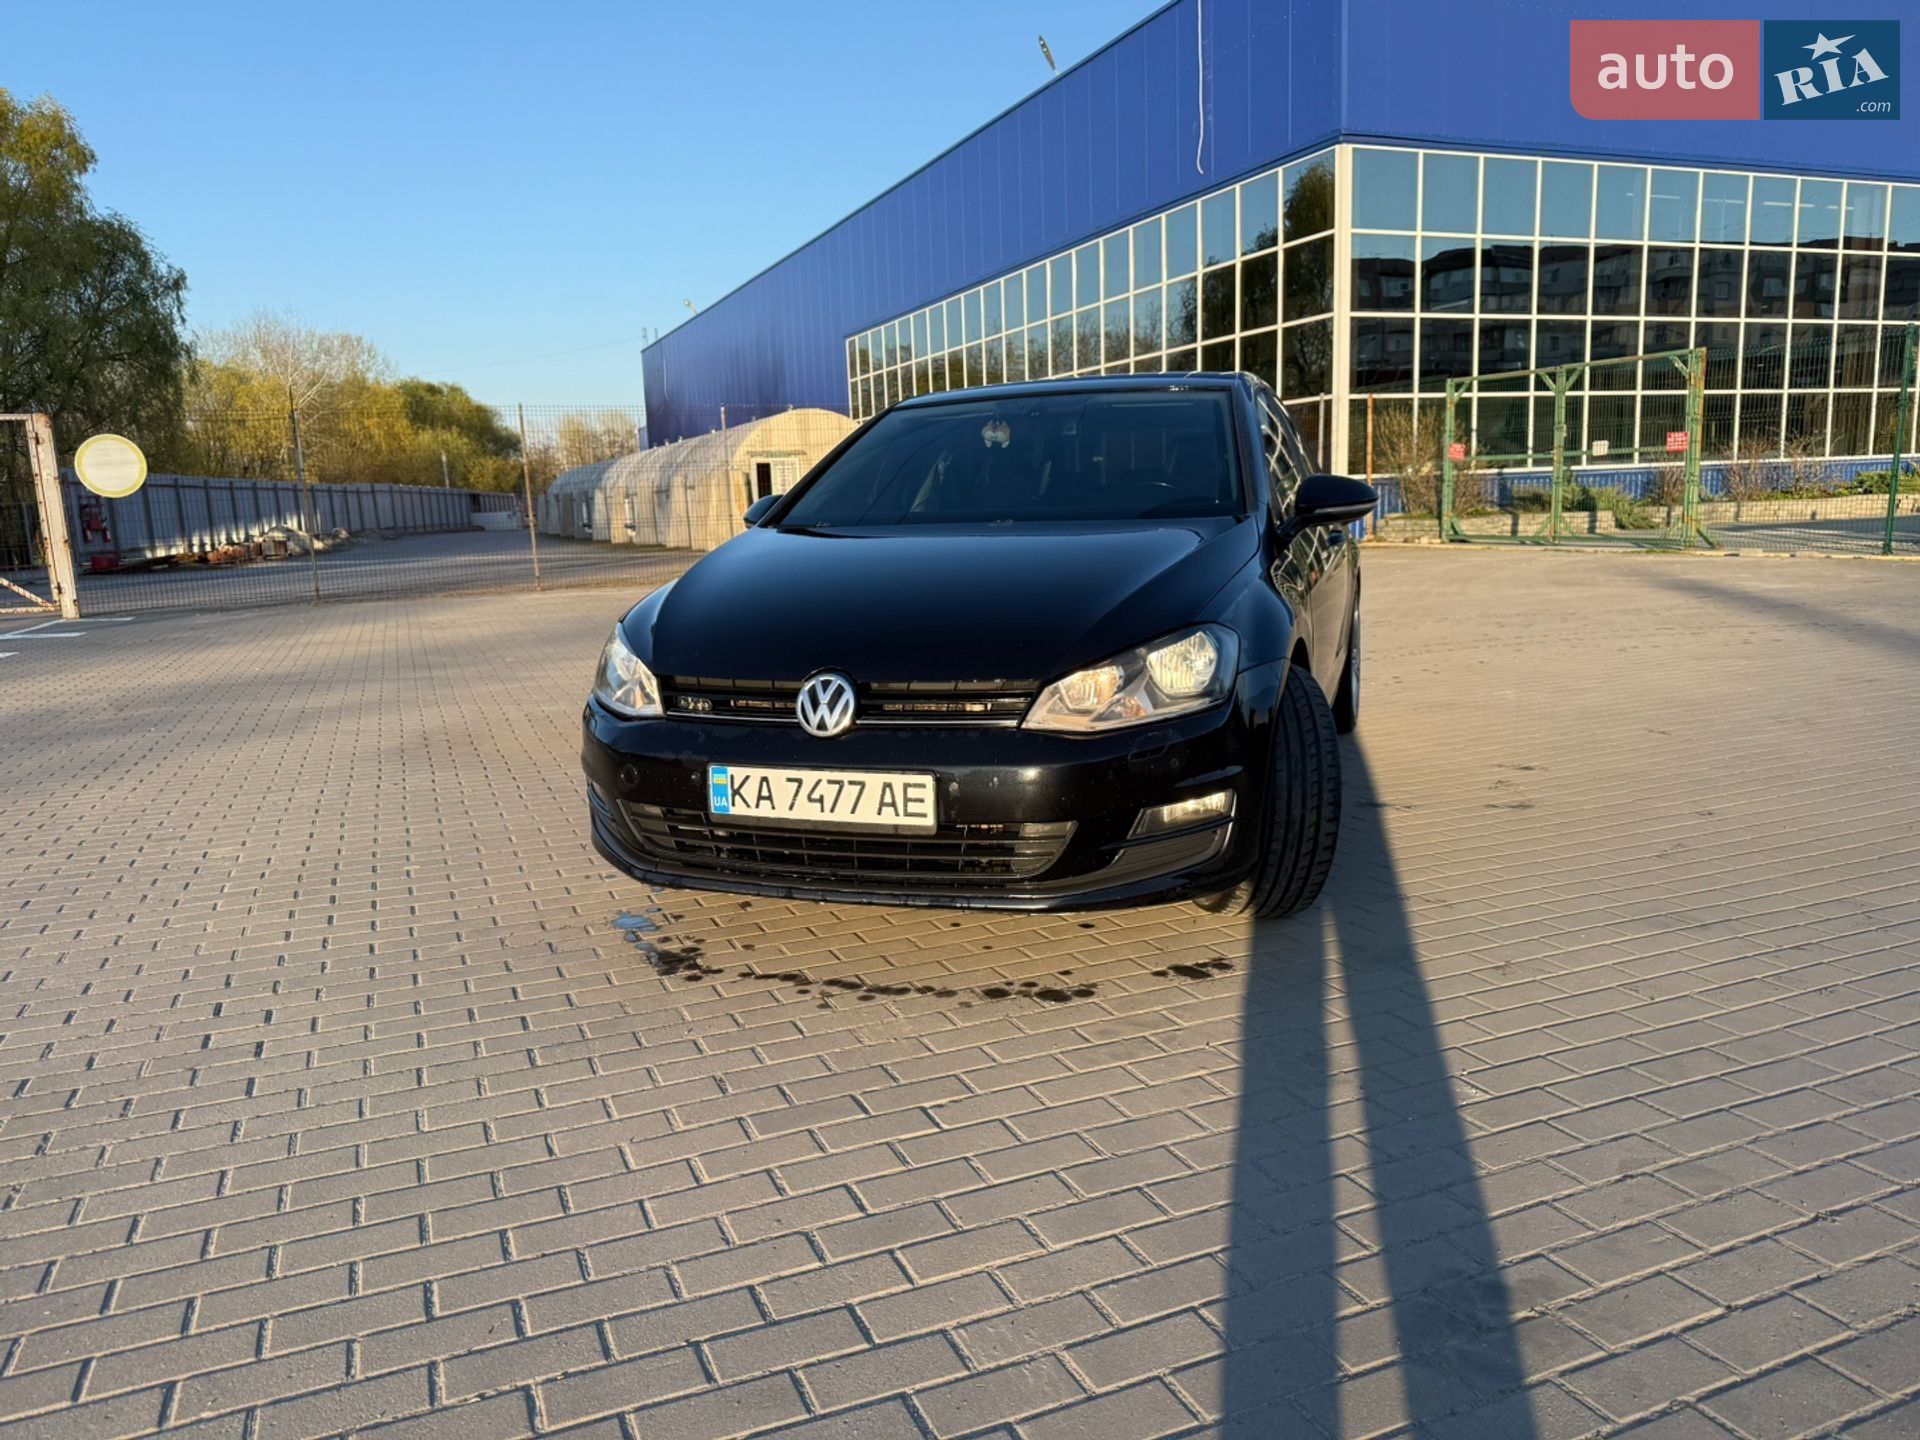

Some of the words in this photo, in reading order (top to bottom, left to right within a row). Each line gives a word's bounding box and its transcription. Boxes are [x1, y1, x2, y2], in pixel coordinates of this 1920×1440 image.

[799, 677, 853, 735] VW
[714, 795, 728, 807] UA
[730, 774, 776, 811] KA
[785, 777, 867, 815] 7477
[876, 781, 928, 819] AE
